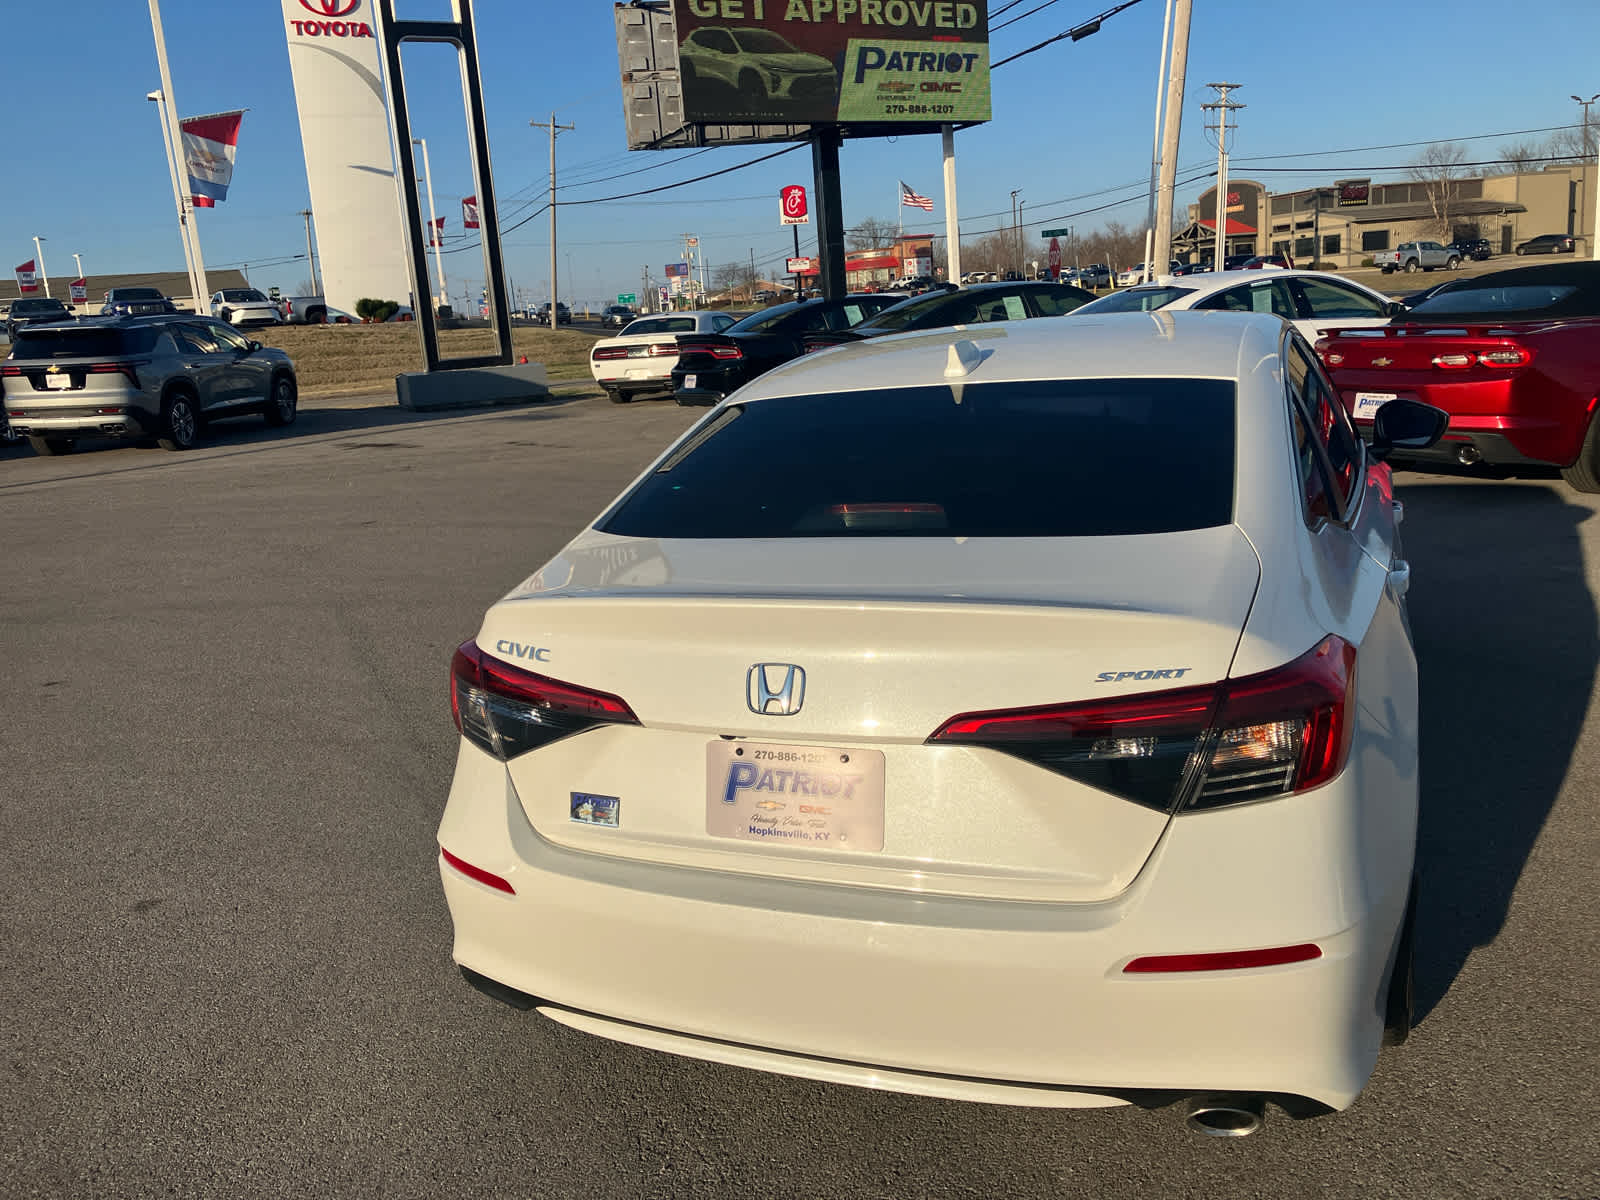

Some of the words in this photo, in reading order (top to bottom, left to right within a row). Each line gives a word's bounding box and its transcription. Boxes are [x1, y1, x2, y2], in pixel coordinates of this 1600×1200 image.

[689, 0, 765, 20] GET
[783, 0, 978, 29] APPROVED
[290, 20, 375, 38] TOYOTA
[854, 46, 979, 84] PATRIOT
[920, 82, 962, 93] GMC
[497, 640, 551, 662] CIVIC
[1095, 668, 1192, 682] SPORT
[723, 761, 863, 803] PATRIOT
[749, 825, 812, 840] Hopkinsville,
[815, 832, 830, 840] KY
